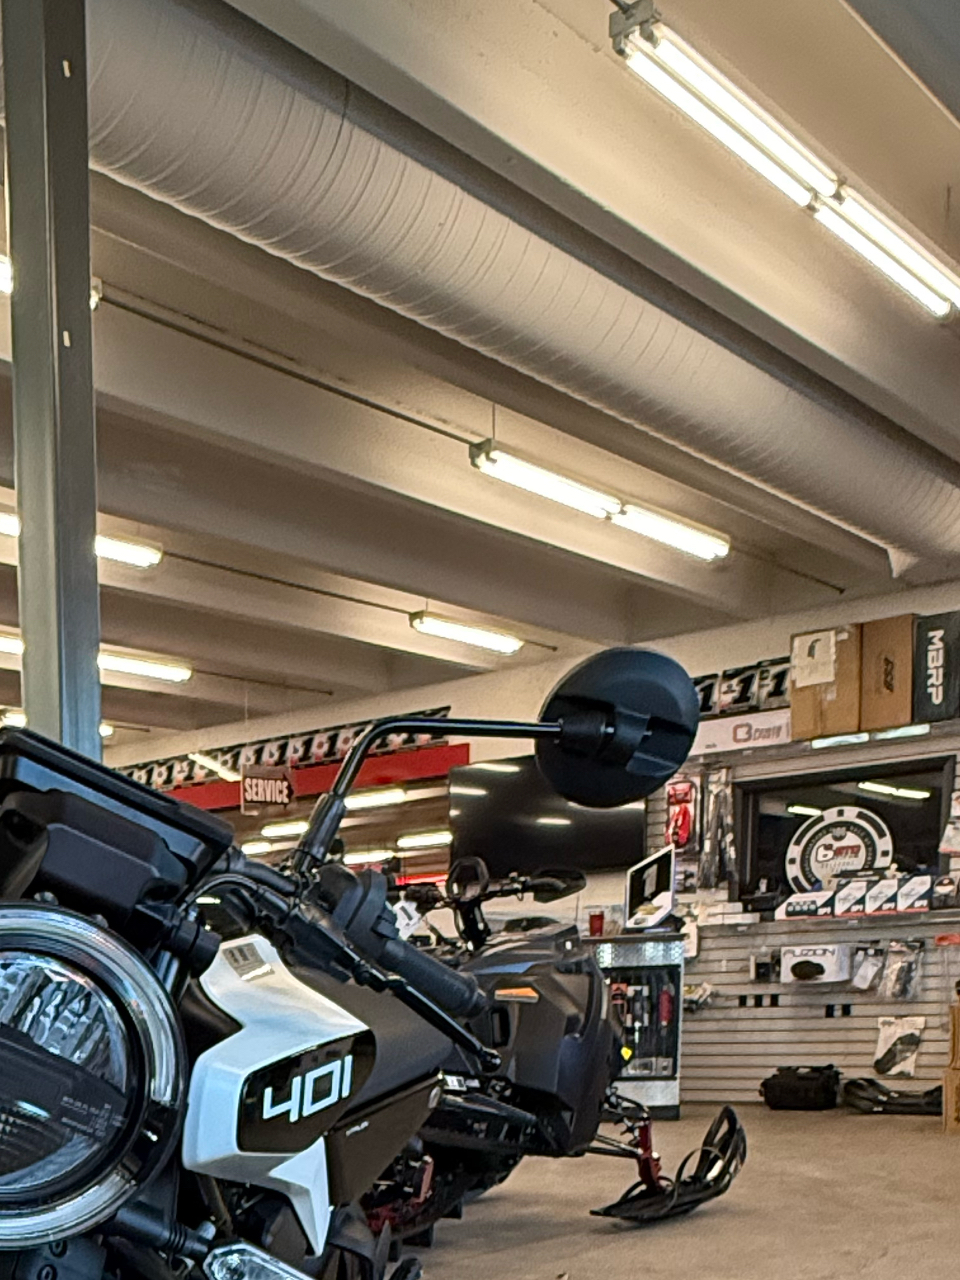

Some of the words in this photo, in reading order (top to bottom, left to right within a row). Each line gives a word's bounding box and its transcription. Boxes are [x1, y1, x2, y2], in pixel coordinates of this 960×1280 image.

[927, 629, 945, 705] MBRP
[244, 777, 290, 803] SERVICE
[262, 1054, 353, 1123] 401
